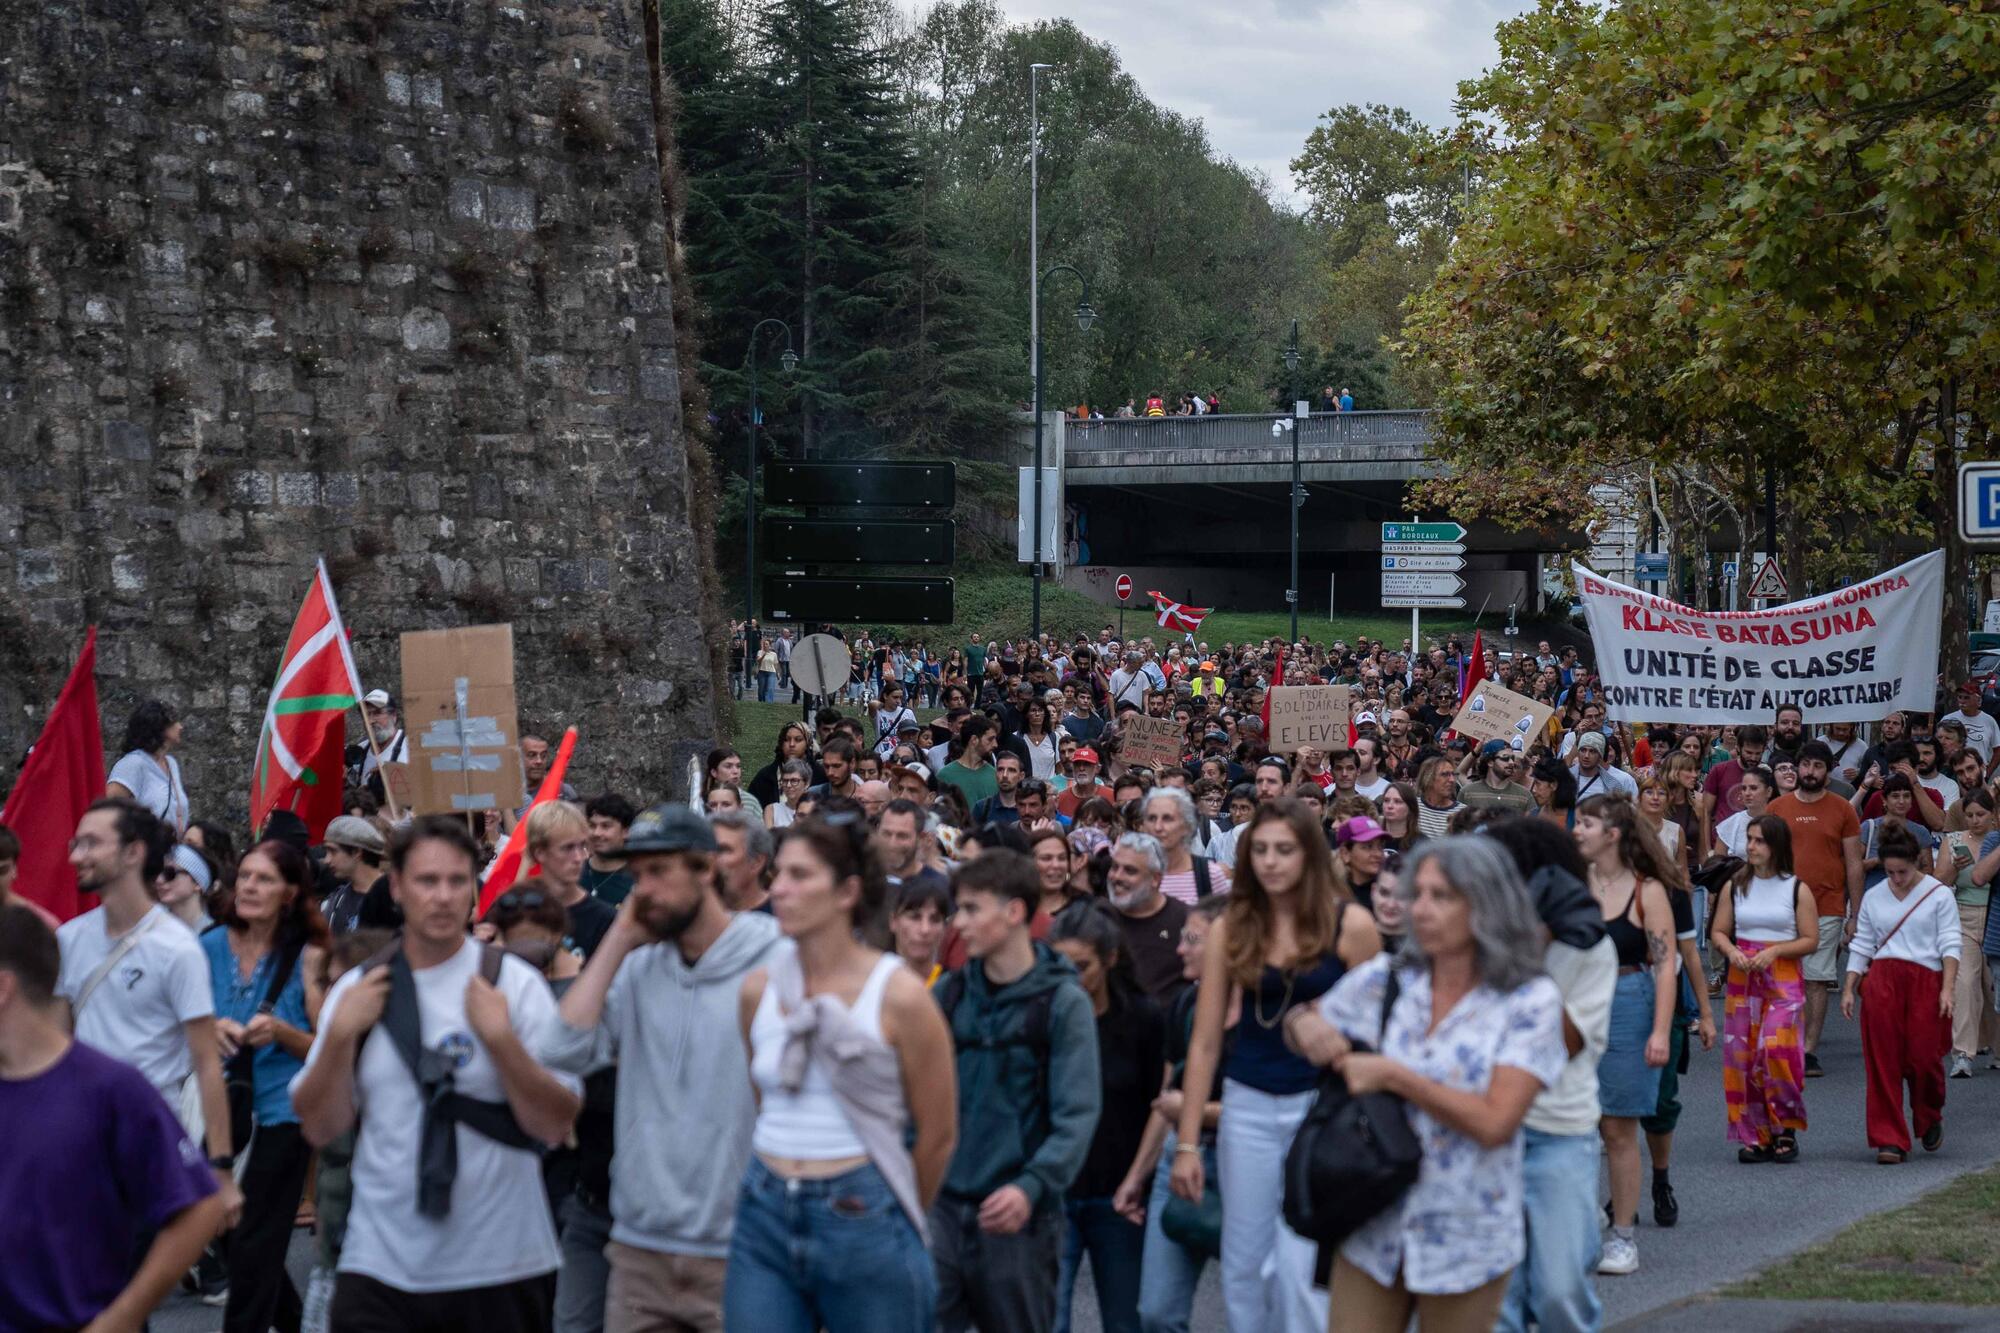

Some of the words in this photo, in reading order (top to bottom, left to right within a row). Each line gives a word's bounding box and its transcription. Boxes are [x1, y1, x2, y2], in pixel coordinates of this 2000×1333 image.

[1833, 575, 1909, 608] KONTRA
[1622, 605, 1712, 640] KLASE
[1716, 607, 1877, 646] BATASUNA
[1624, 646, 1717, 679] UNITÉ
[1724, 656, 1762, 682] DE
[1771, 646, 1876, 679] CLASSE
[1273, 699, 1347, 715] SOLIDAIRES
[1603, 685, 1683, 708] CONTRE
[1689, 685, 1756, 710] L'ÉTAT
[1760, 677, 1902, 710] AUTORITAIRE
[1282, 723, 1348, 744] ELEVES
